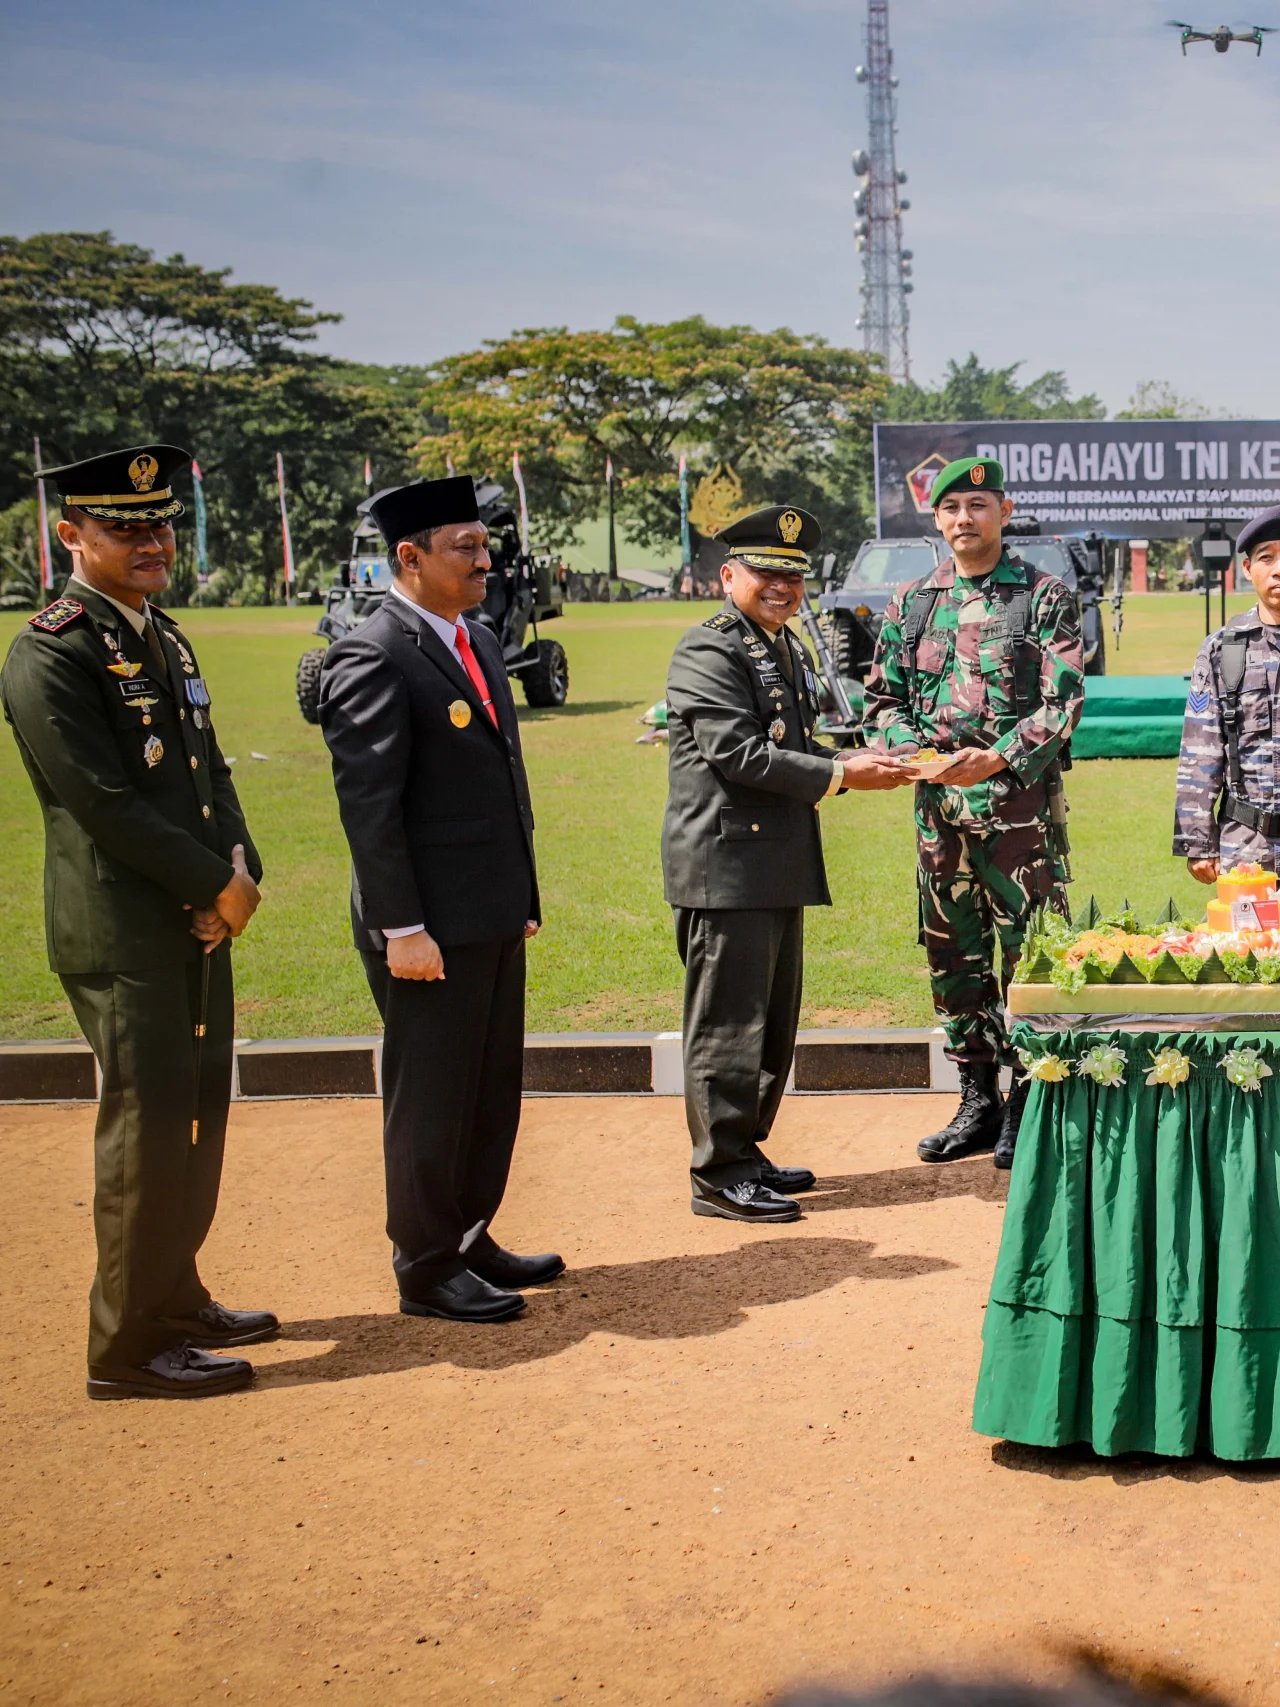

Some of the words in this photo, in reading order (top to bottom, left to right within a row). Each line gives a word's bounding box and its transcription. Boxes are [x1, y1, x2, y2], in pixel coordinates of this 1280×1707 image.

[1174, 441, 1229, 481] TNI
[1066, 490, 1136, 504] BERSAMA
[1137, 489, 1195, 503] RAKYAT
[1087, 508, 1161, 522] NASIONAL
